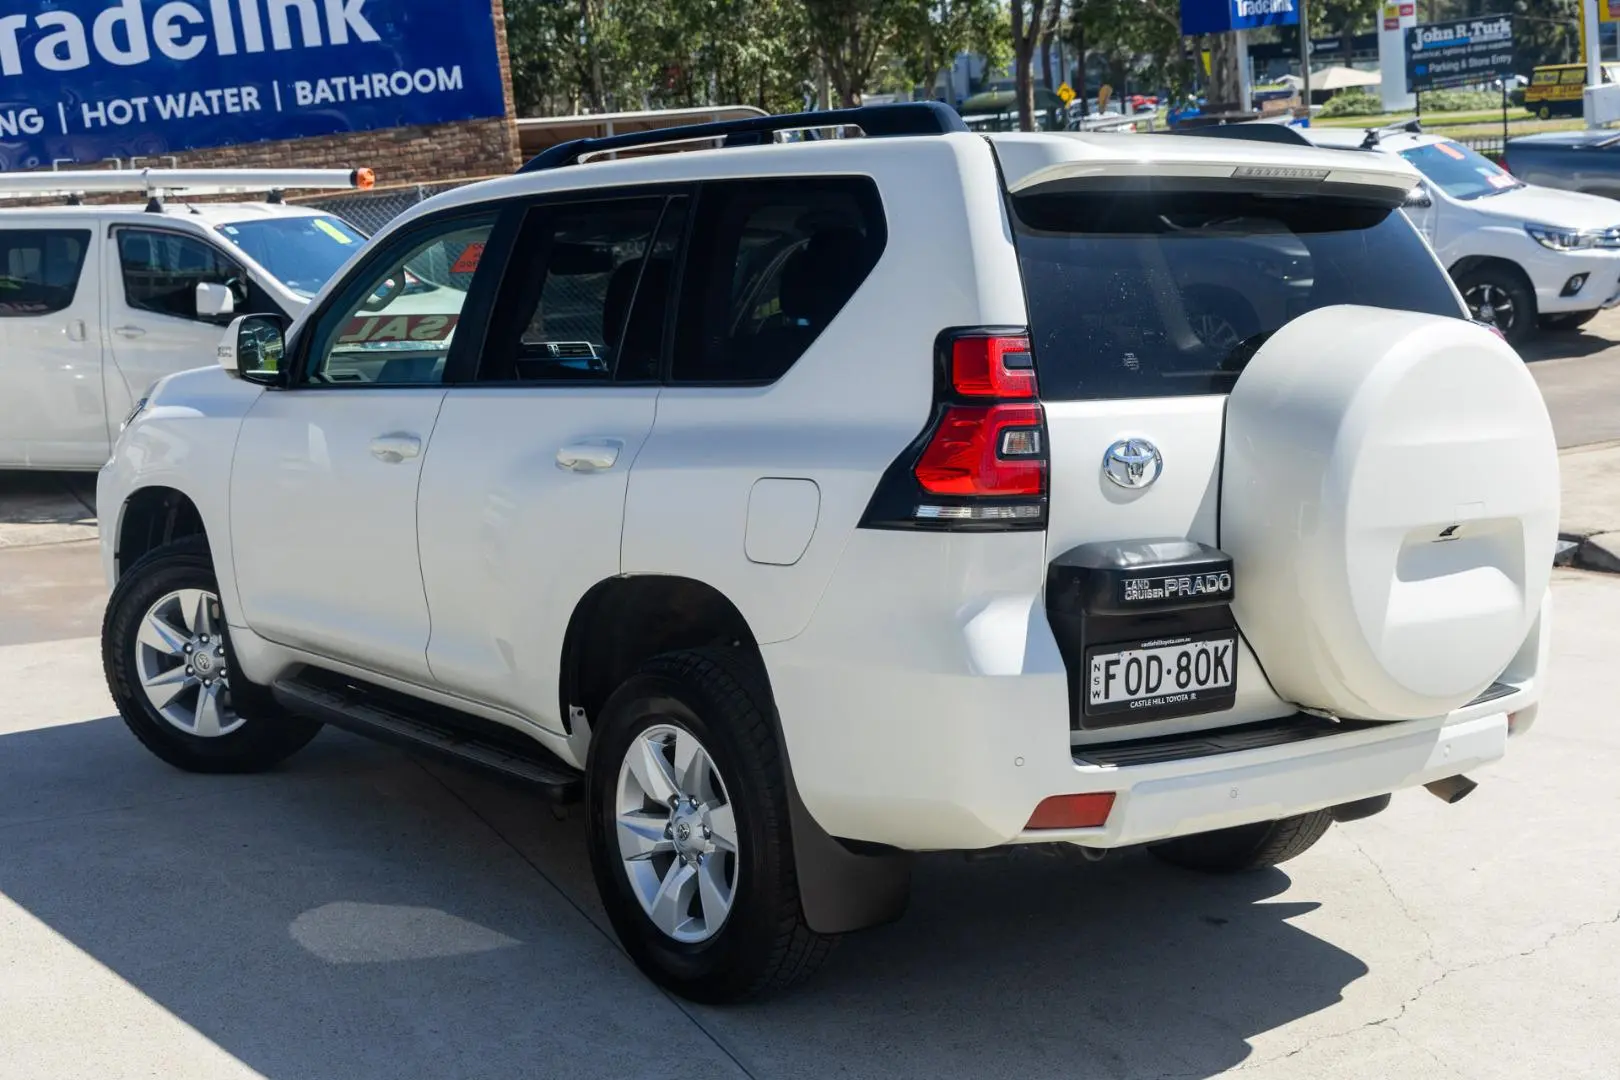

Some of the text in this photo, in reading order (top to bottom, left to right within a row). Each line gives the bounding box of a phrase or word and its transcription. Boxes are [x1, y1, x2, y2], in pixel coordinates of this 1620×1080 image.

[1411, 27, 1454, 51] John
[1470, 18, 1511, 36] Turk
[1428, 61, 1460, 73] Parking
[1461, 59, 1467, 69] &
[1491, 54, 1513, 65] Entry
[81, 97, 149, 129] HOT
[153, 86, 261, 120] WATER
[295, 65, 463, 106] BATHROOM
[1124, 573, 1232, 598] LAND PRADO
[1124, 588, 1164, 601] CRUISER
[1130, 697, 1152, 709] CASTLE
[1152, 696, 1166, 706] HILL
[1166, 694, 1189, 704] TOYOTA
